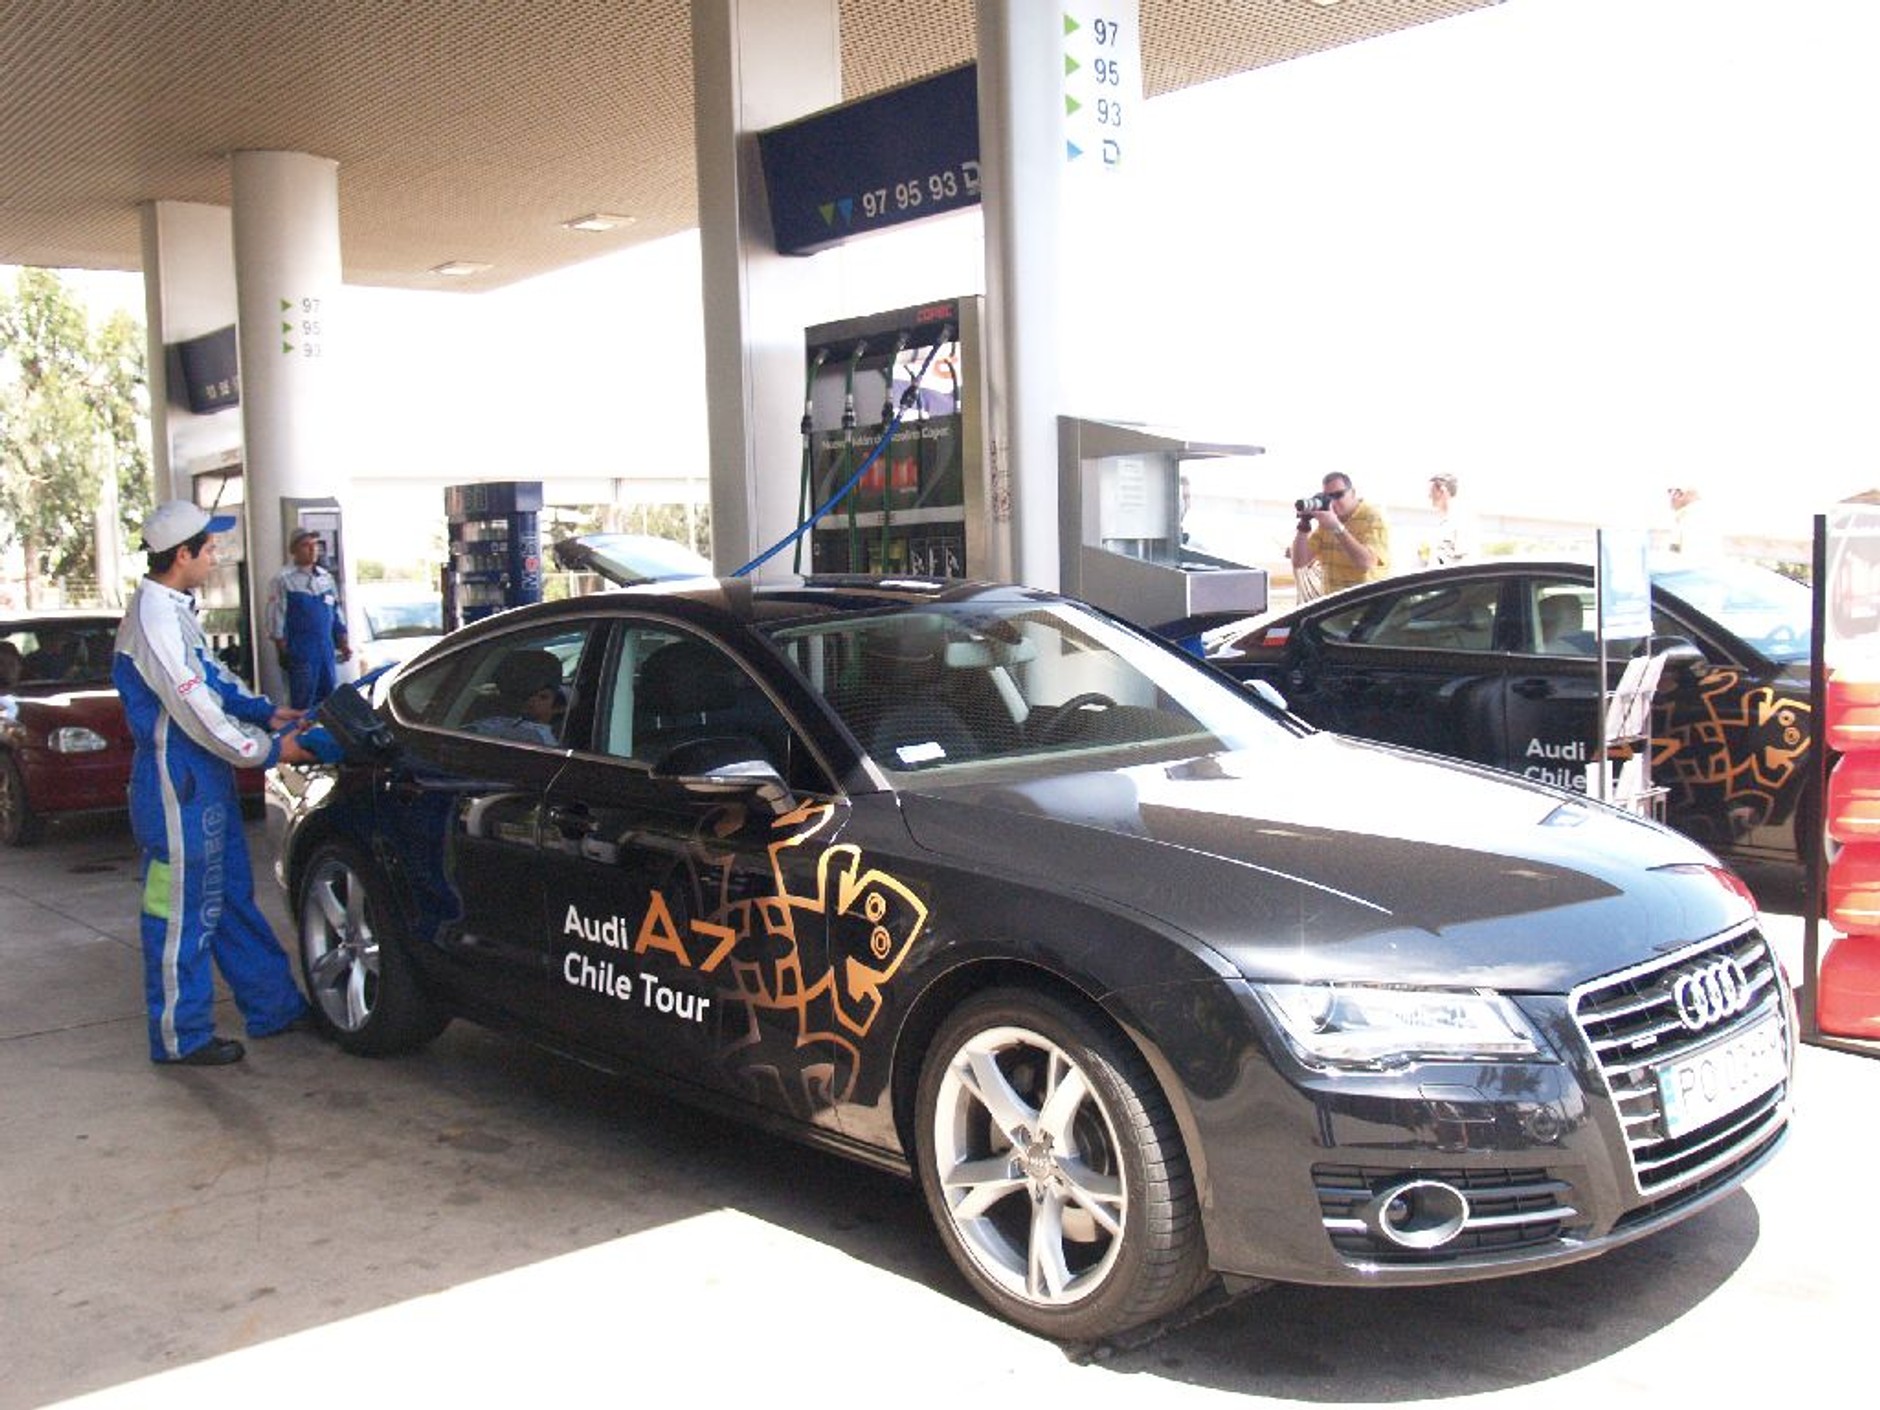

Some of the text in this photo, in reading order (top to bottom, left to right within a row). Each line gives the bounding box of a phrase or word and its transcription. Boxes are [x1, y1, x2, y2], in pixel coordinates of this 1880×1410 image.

[1093, 18, 1118, 47] 97
[1093, 58, 1120, 86] 95
[1097, 98, 1121, 127] 93
[862, 188, 888, 218] 97
[895, 180, 922, 209] 95
[928, 171, 958, 200] 93
[1525, 738, 1586, 761] Audi
[1525, 766, 1587, 790] Chile
[563, 889, 737, 972] Audi A7
[563, 952, 711, 1022] Chile Tour
